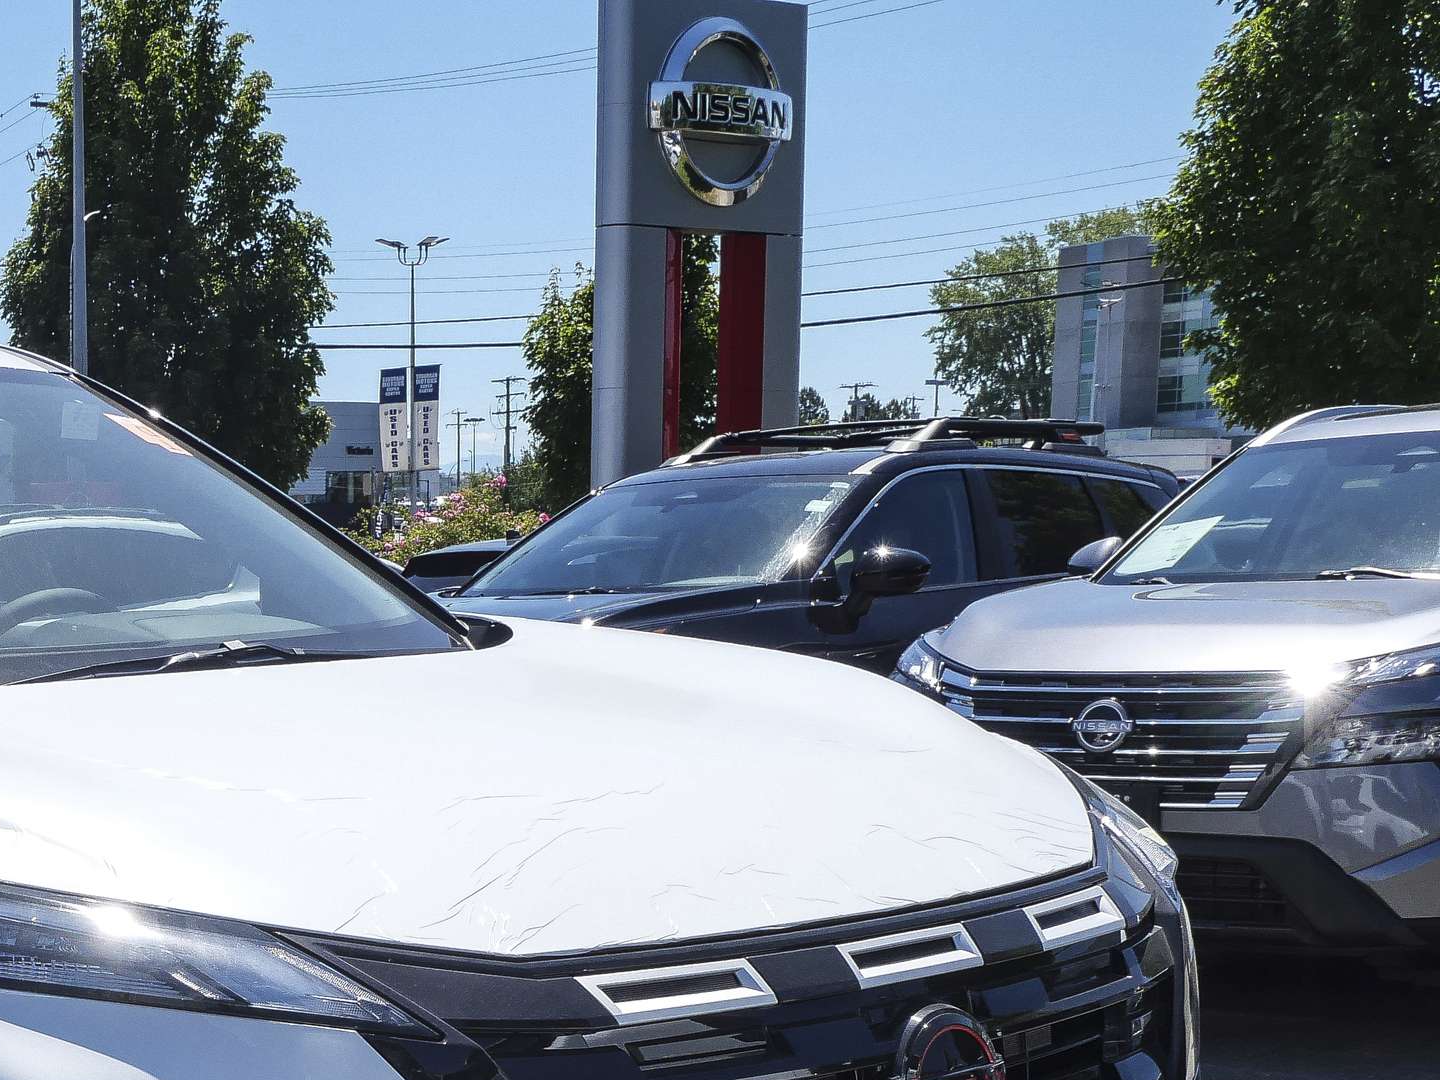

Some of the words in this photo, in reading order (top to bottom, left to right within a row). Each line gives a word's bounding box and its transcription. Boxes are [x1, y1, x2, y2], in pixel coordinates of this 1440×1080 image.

[671, 90, 786, 130] NISSAN
[390, 409, 398, 436] USED
[1073, 722, 1131, 731] NISSAN
